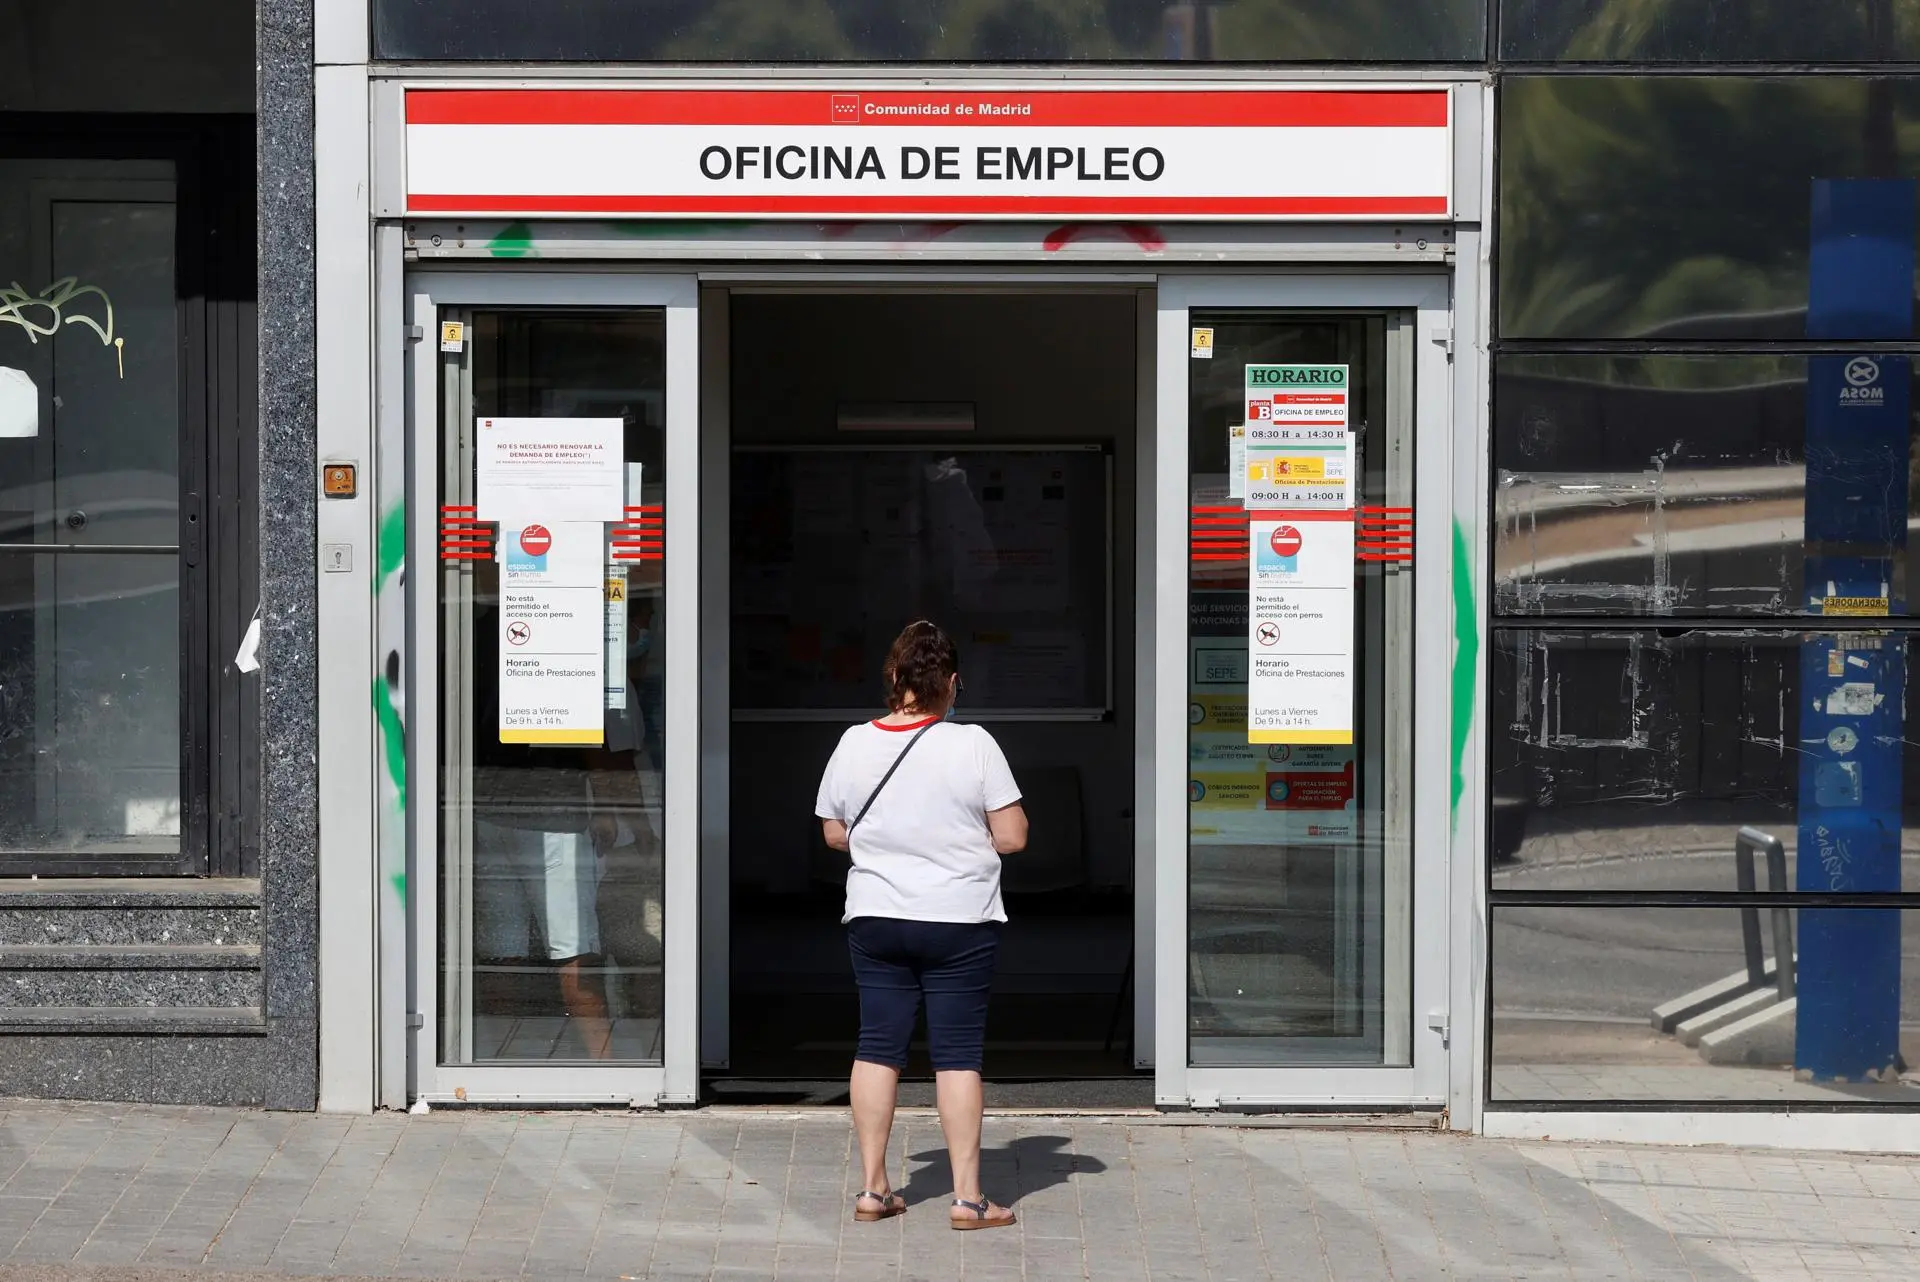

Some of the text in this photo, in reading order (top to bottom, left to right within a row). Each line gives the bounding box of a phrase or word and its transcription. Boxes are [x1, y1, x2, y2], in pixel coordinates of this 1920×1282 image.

[864, 103, 1031, 115] Comunidad de Madrid
[699, 145, 1166, 182] OFICINA DE EMPLEO
[1252, 369, 1344, 383] HORARIO
[1258, 406, 1271, 420] B
[1251, 430, 1279, 438] 08:30
[1307, 430, 1334, 438] 14:30
[1260, 467, 1270, 480] 1
[1326, 468, 1344, 476] SEPE
[1251, 492, 1279, 500] 09:00
[1307, 492, 1334, 500] 14:00
[507, 562, 536, 571] espacio
[506, 659, 540, 667] Horario
[1256, 660, 1289, 668] Horario
[506, 668, 596, 677] Oficina de Prestaciones
[1206, 667, 1237, 680] SEPE
[1255, 669, 1345, 678] Oficina de Prestaciones
[505, 707, 530, 715] Lunes
[539, 707, 569, 715] Viernes
[1255, 708, 1279, 716] Lunes
[1288, 708, 1318, 716] Viernes
[505, 717, 518, 725] De
[519, 717, 525, 725] 9
[526, 717, 535, 725] h.
[544, 717, 554, 725] 14
[555, 717, 564, 725] h.
[1255, 717, 1267, 725] De
[1268, 717, 1274, 725] 9
